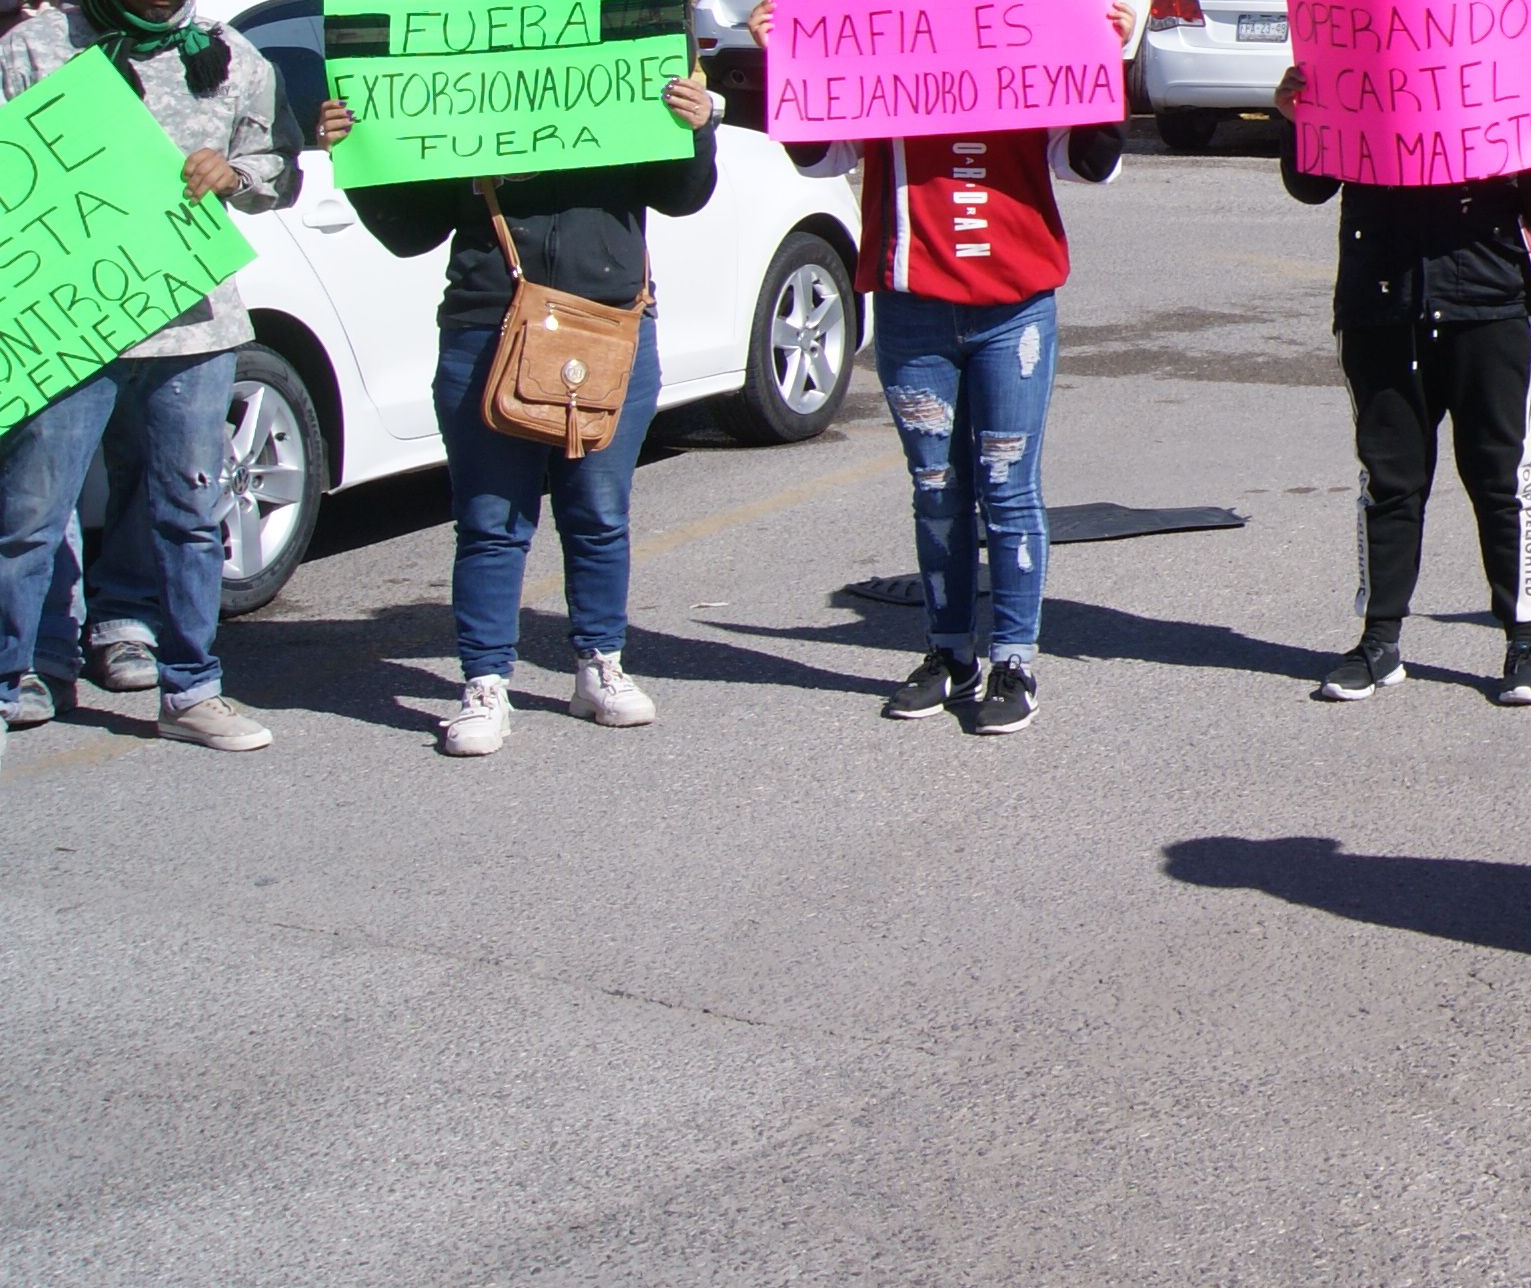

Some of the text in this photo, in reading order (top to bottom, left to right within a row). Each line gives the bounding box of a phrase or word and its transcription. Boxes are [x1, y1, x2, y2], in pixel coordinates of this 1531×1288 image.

[403, 1, 591, 53] FUERA
[792, 3, 1033, 59] MAFIA ES
[774, 63, 1116, 122] ALEJANDRO REYNA
[1336, 62, 1521, 113] CARTEL
[396, 125, 602, 160] FUERA
